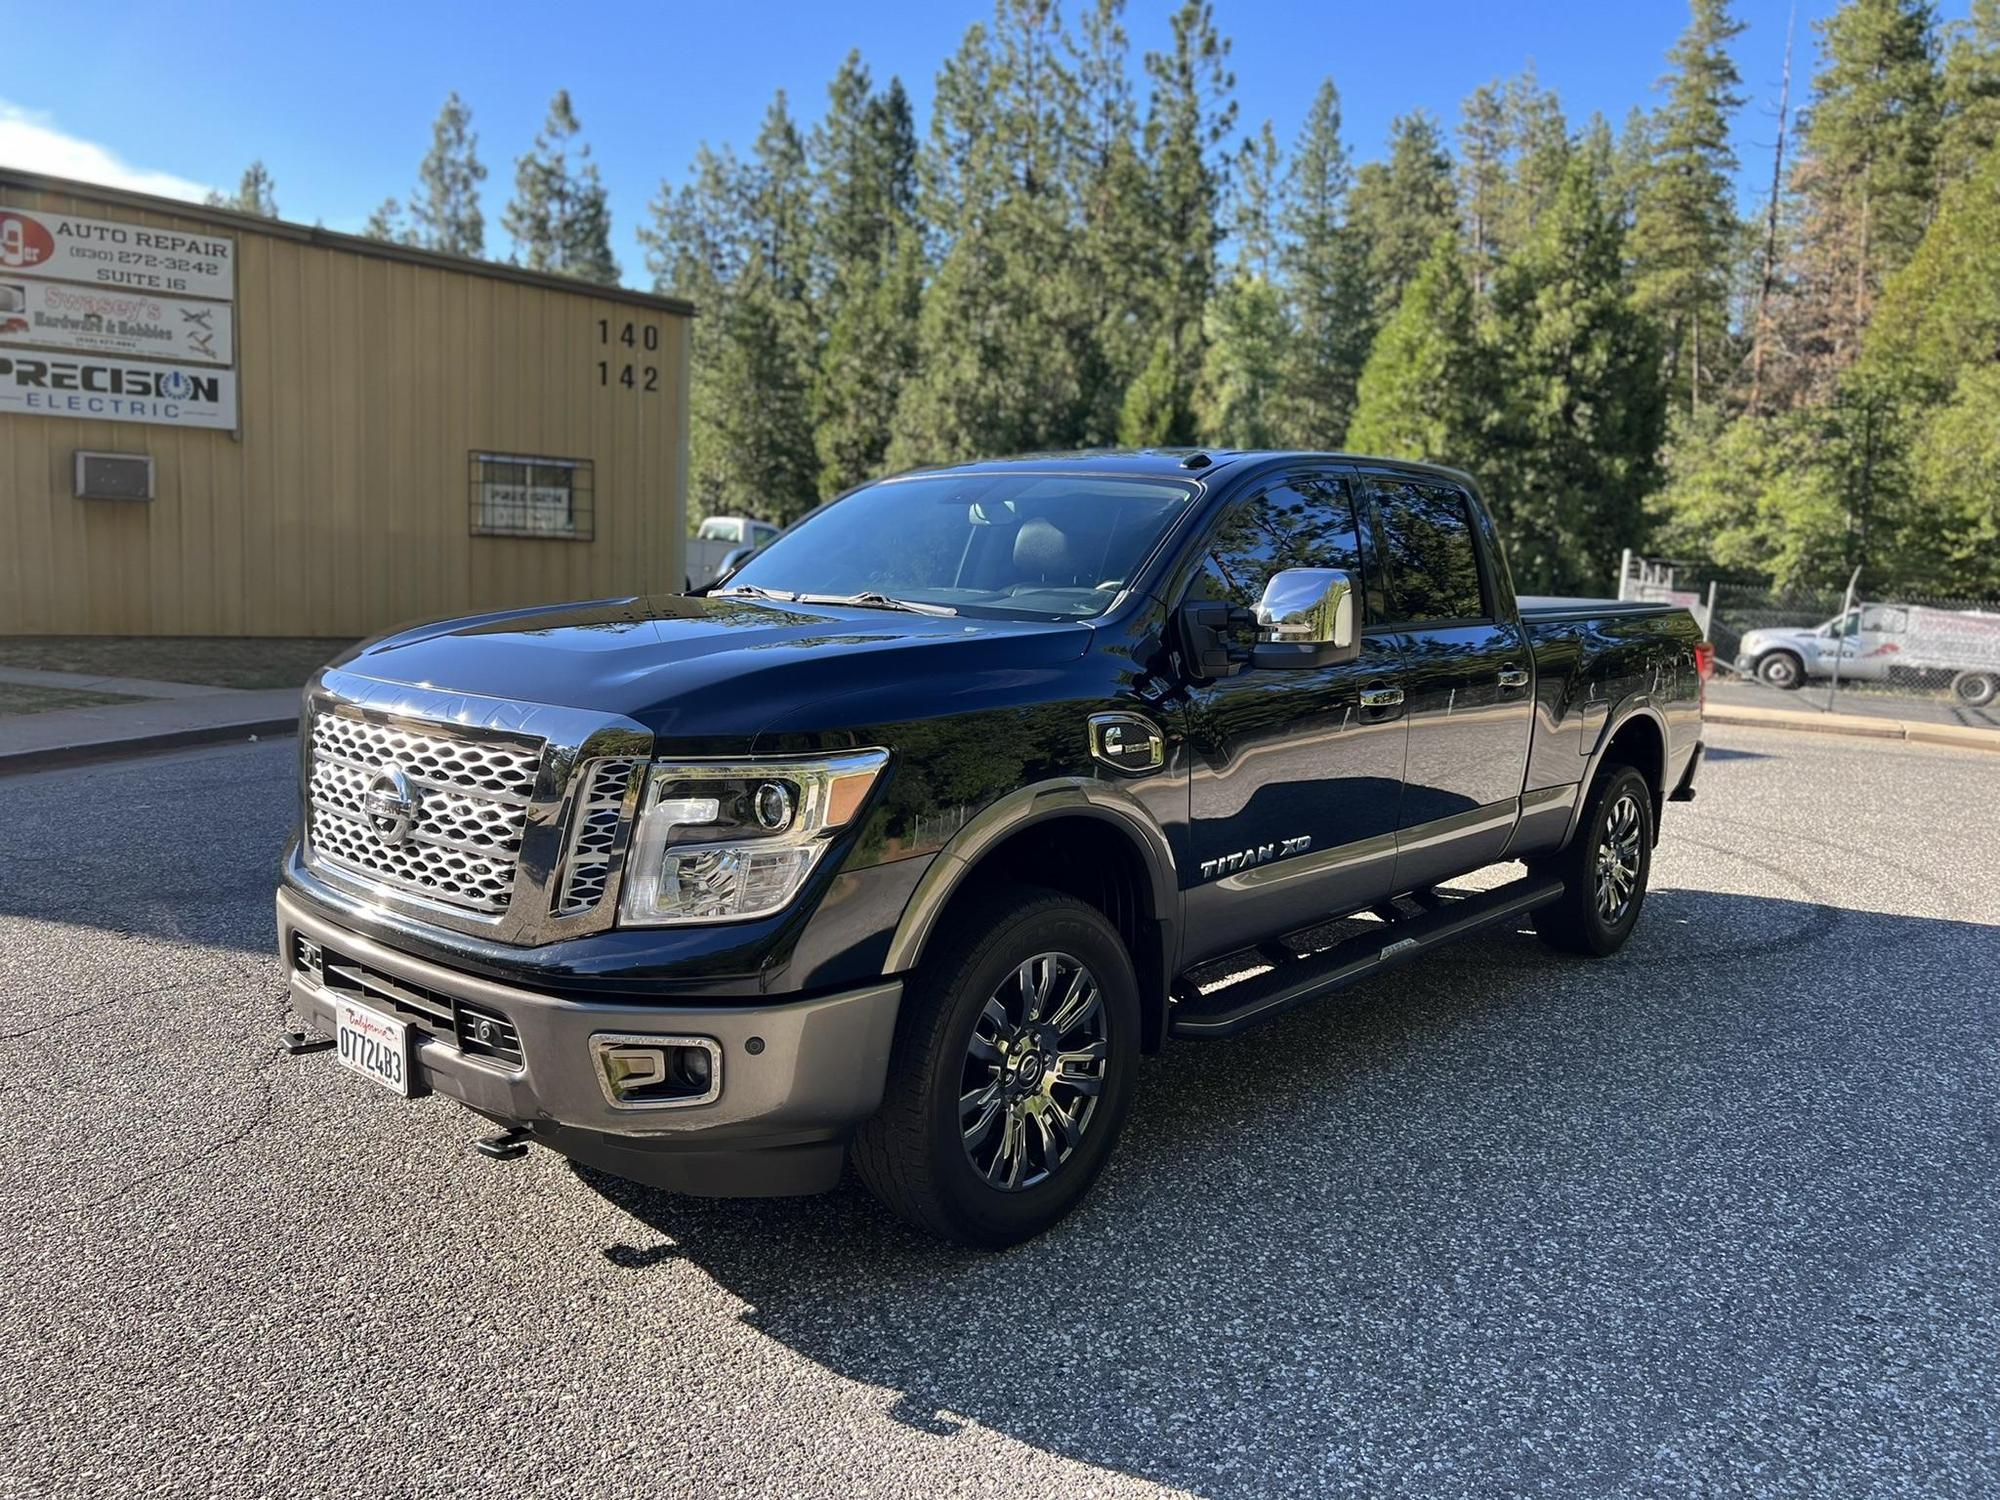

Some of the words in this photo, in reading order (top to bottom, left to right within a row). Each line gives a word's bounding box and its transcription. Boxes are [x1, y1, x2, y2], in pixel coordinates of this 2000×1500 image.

[57, 221, 127, 244] AUTO
[136, 231, 228, 258] REPAIR
[97, 268, 161, 288] SUITE
[167, 277, 187, 291] 16
[118, 251, 219, 276] 272-3242
[45, 286, 162, 322] Swasey's
[598, 318, 658, 351] 140
[598, 361, 658, 392] 142
[27, 393, 179, 418] ELECTRIC
[1200, 843, 1275, 879] TITAN
[1280, 835, 1312, 857] XD
[340, 1026, 401, 1084] 07724B3
